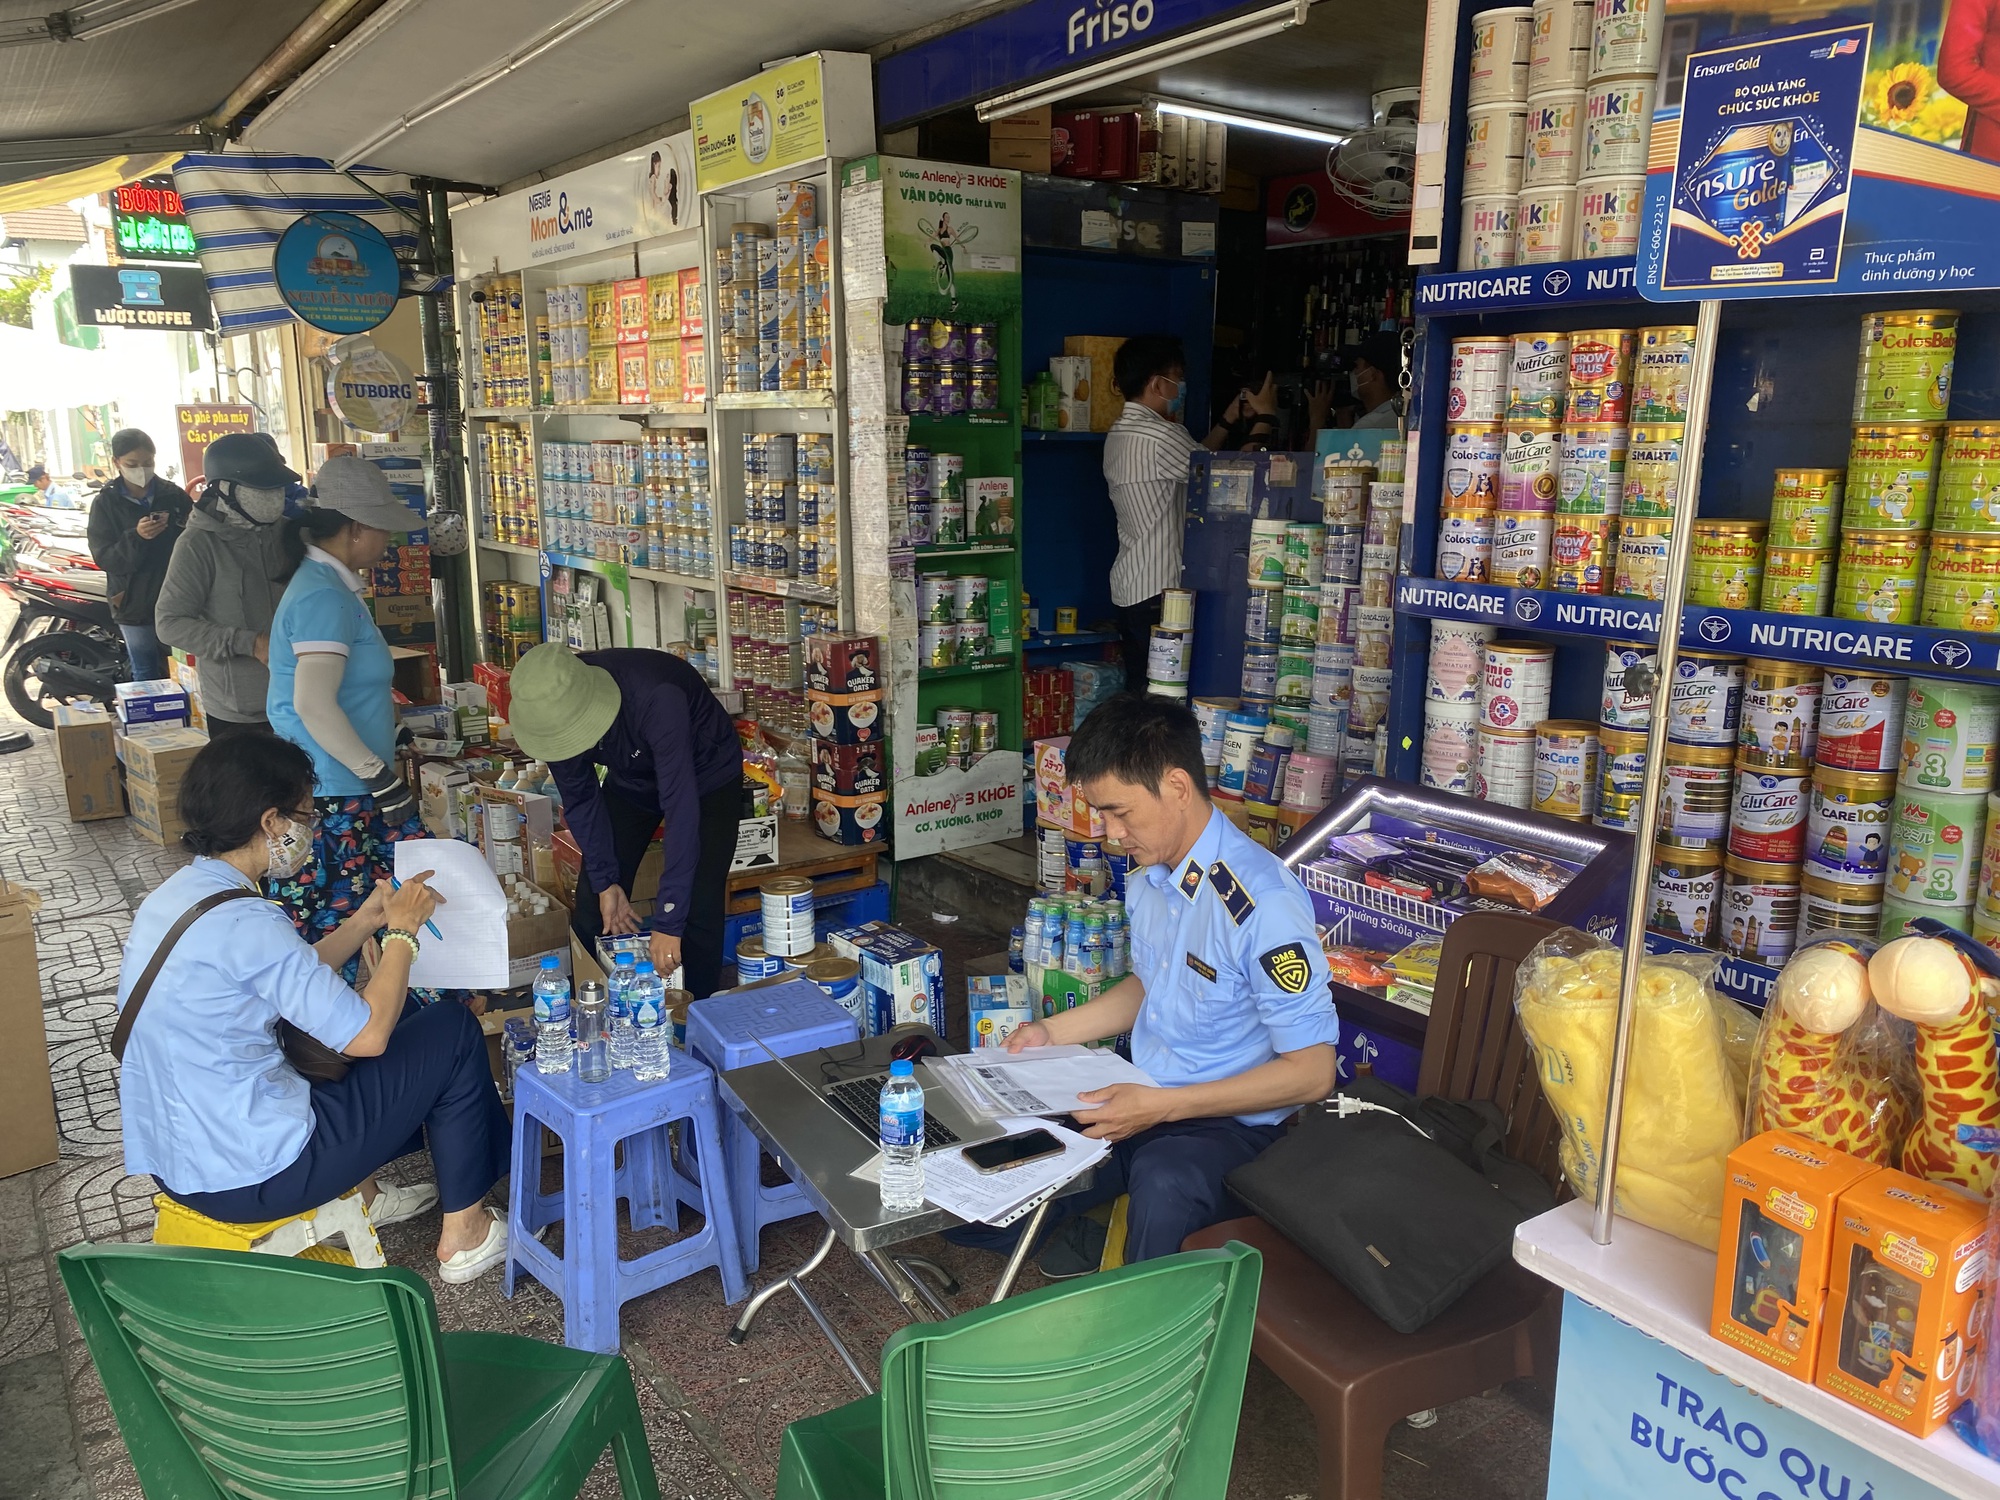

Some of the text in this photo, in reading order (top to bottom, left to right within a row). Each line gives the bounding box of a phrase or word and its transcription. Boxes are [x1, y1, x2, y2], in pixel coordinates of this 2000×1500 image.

[1068, 0, 1154, 54] Friso
[1735, 86, 1749, 98] BỘ
[1777, 78, 1806, 93] TẶNG
[1588, 91, 1643, 119] Hikid
[1718, 91, 1820, 116] CHÚC SỨC KHỎE
[1527, 106, 1575, 132] Hikid
[922, 170, 957, 184] Anlene
[968, 174, 975, 185] 3
[978, 174, 1007, 189] KHỎE
[900, 186, 926, 204] VẬN
[928, 188, 963, 206] ĐỘNG
[984, 199, 993, 208] LÀ
[994, 201, 1006, 209] VUI
[1583, 192, 1640, 216] Hikid
[530, 216, 558, 242] Mom
[574, 207, 593, 231] me
[1474, 210, 1517, 232] Hiki
[1646, 195, 1666, 285] ENS-C-606-22-15
[1864, 248, 1935, 265] Thực phẩm
[1862, 265, 1975, 282] dinh dưỡng y học
[1422, 275, 1532, 303] NUTRICARE
[137, 310, 193, 326] COFFEE
[1516, 353, 1566, 373] NutriCare
[1573, 352, 1608, 364] GROW
[1538, 370, 1563, 382] Fine
[1576, 364, 1603, 373] PLUS
[342, 382, 412, 399] TUBORG
[181, 410, 249, 426] Cà phê pha máy
[187, 429, 207, 443] Các
[384, 445, 408, 453] BLANC
[1504, 444, 1551, 462] NutriCare
[1560, 448, 1606, 460] olosCare
[1555, 536, 1587, 547] GROW
[1501, 548, 1533, 559] Gastro
[1557, 547, 1581, 556] PLUS
[1400, 587, 1505, 615] NUTRICARE
[1750, 623, 1914, 660] NUTRICARE
[814, 683, 825, 691] OATS
[847, 676, 875, 688] QUAKER
[853, 684, 869, 692] OATS
[1834, 714, 1867, 729] Gold
[1556, 767, 1579, 777] Adult
[1924, 753, 1946, 778] 3
[821, 783, 832, 792] OATS
[855, 778, 881, 790] QUAKER
[860, 785, 875, 793] OATS
[905, 784, 1015, 817] Anlene 3 KHỎE
[1740, 794, 1798, 808] GluCare
[976, 807, 1003, 822] KHỚP
[1765, 811, 1797, 827] Gold
[1931, 868, 1953, 892] 3
[1327, 900, 1413, 938] Tận hưởng Sôcôla
[1272, 949, 1297, 965] DMS
[1733, 1177, 1757, 1188] GROW
[1773, 1203, 1791, 1216] CHO
[1845, 1220, 1870, 1232] GROW
[1889, 1250, 1909, 1263] CHO
[1656, 1372, 1768, 1458] TRAO
[1631, 1412, 1748, 1500] BƯỚC
